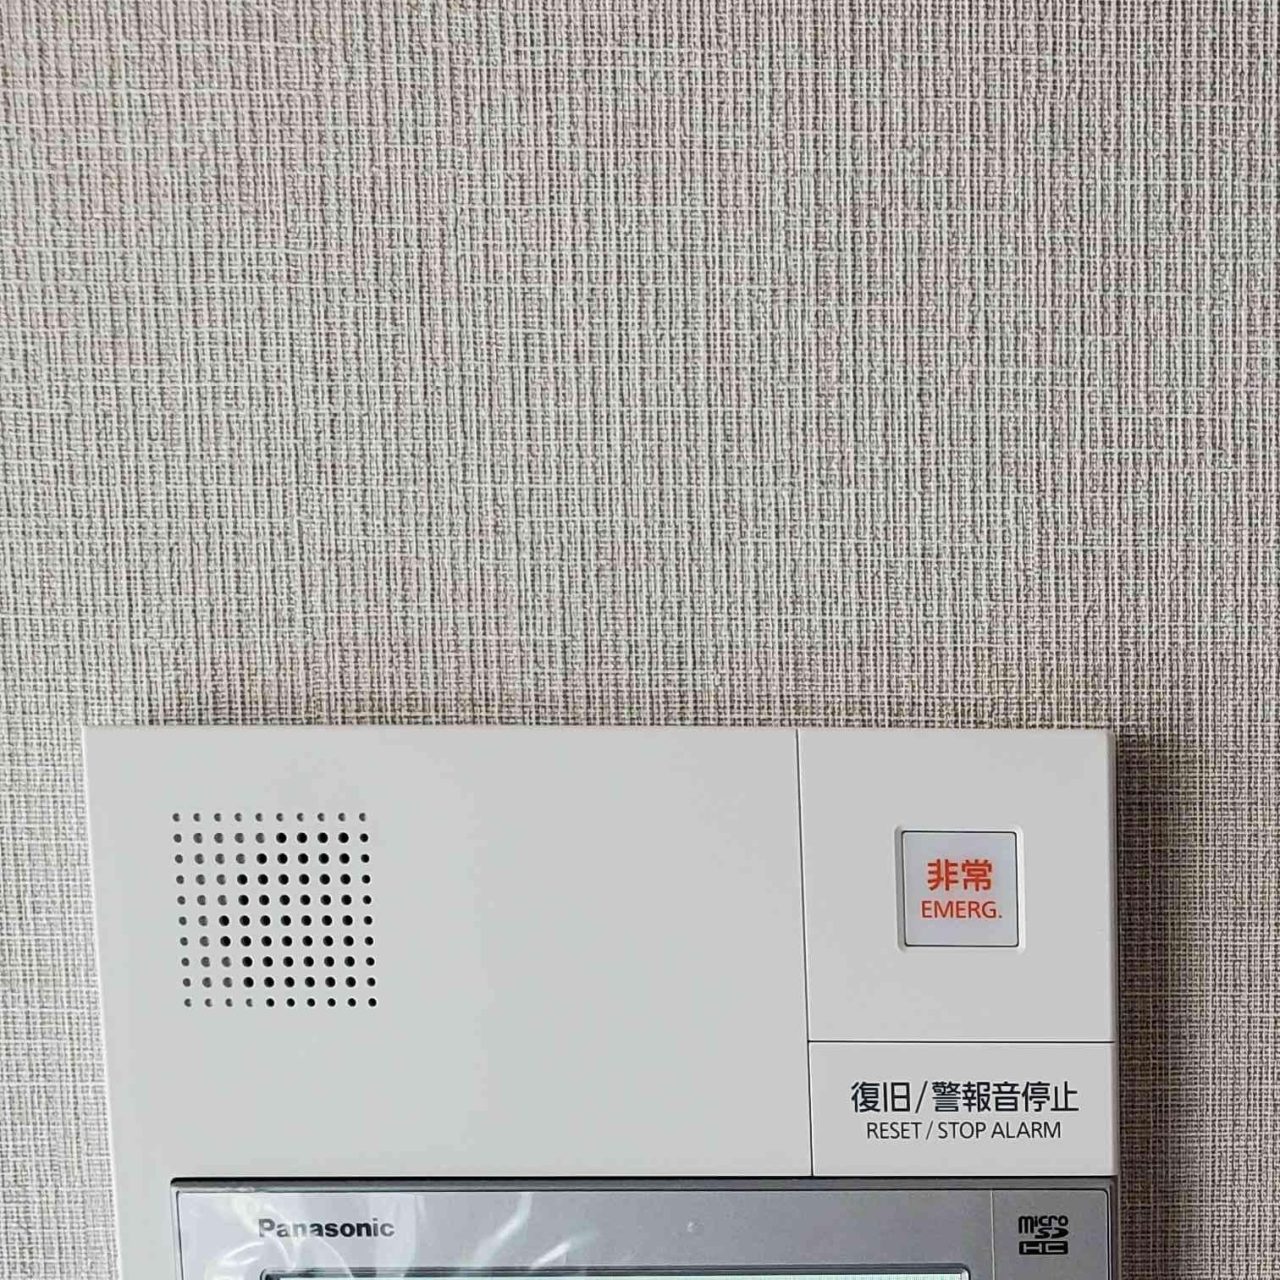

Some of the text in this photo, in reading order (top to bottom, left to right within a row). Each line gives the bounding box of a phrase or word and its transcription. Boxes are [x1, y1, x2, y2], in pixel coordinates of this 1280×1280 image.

[927, 859, 992, 891] 非常
[921, 901, 1002, 918] EMERG.
[851, 1081, 1079, 1113] 復旧/警報音停止
[866, 1122, 922, 1139] RESET
[937, 1122, 987, 1139] STOP
[991, 1121, 1061, 1139] ALARM
[258, 1218, 395, 1237] Panasonic
